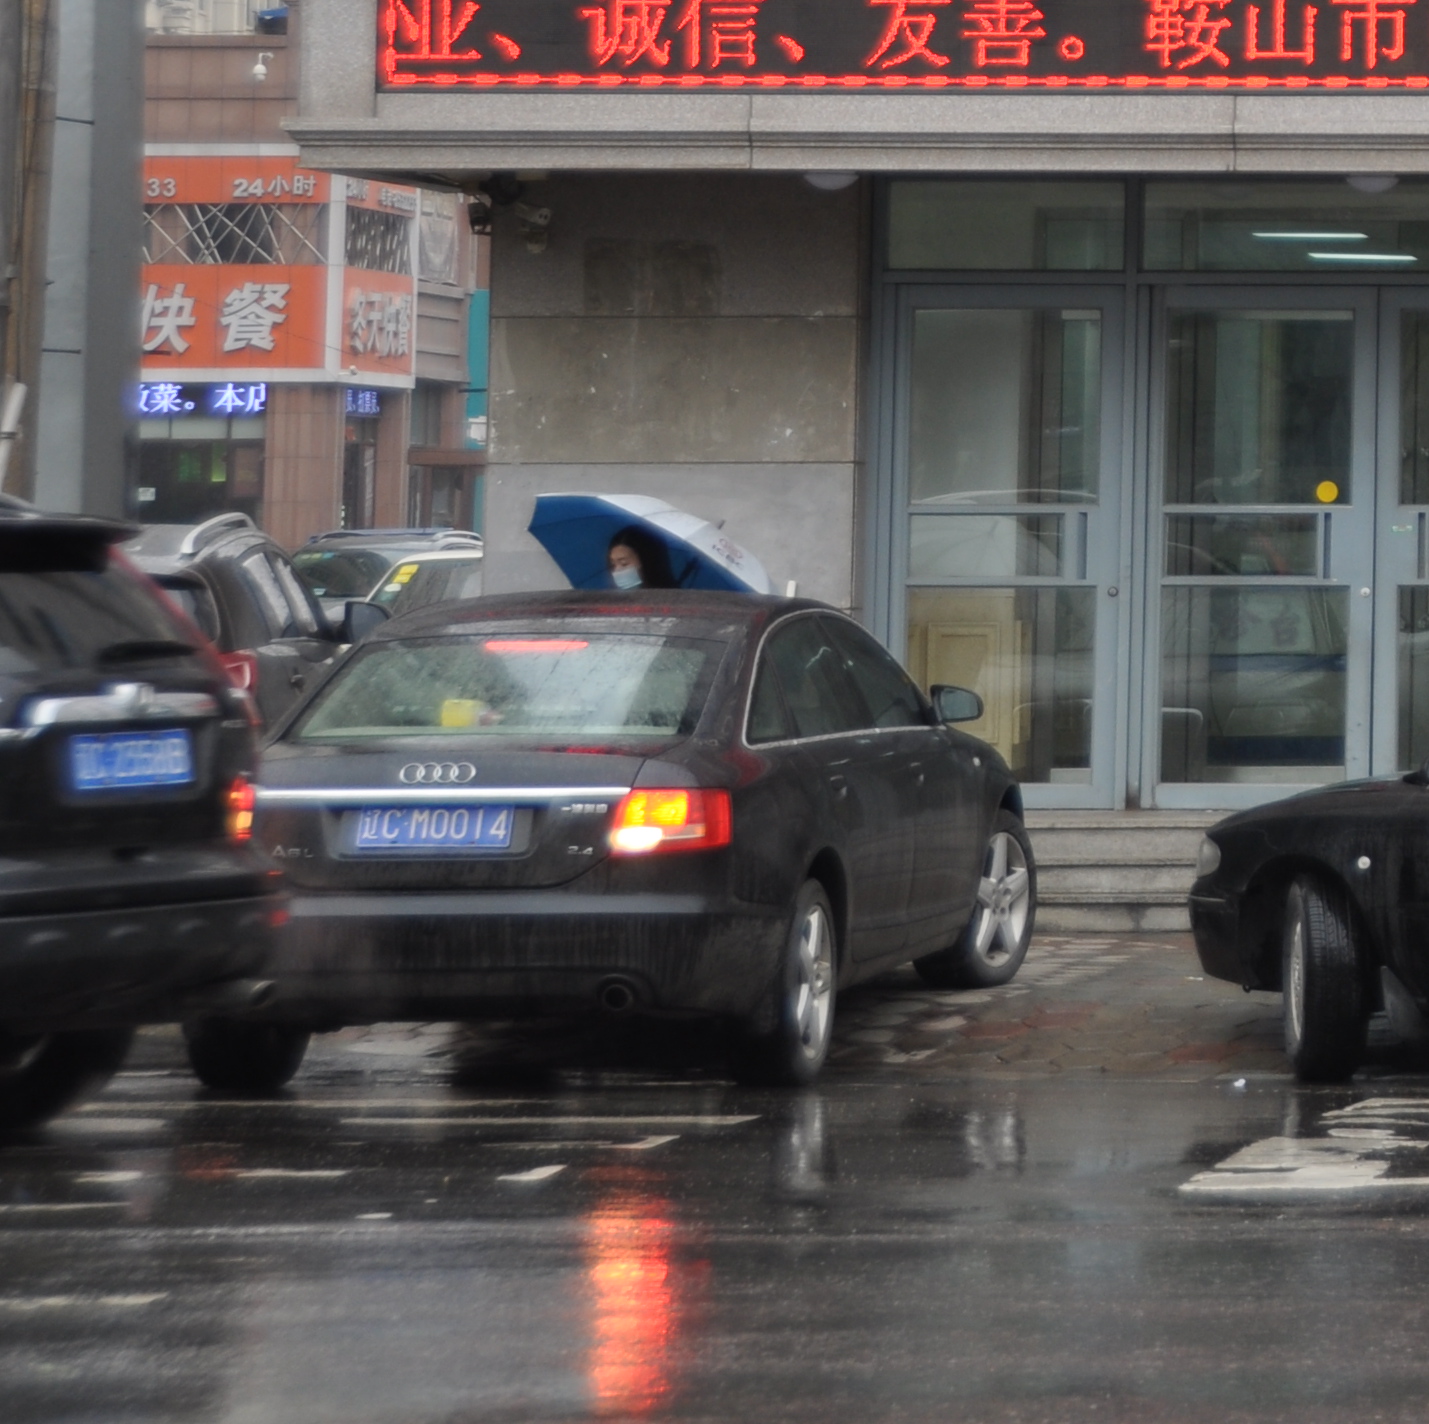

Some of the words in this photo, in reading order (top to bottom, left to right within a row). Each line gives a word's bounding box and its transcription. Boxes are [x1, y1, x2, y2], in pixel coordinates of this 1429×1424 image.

[233, 175, 316, 198] 24小时
[142, 282, 290, 354] 快餐
[568, 845, 593, 855] 2.4
